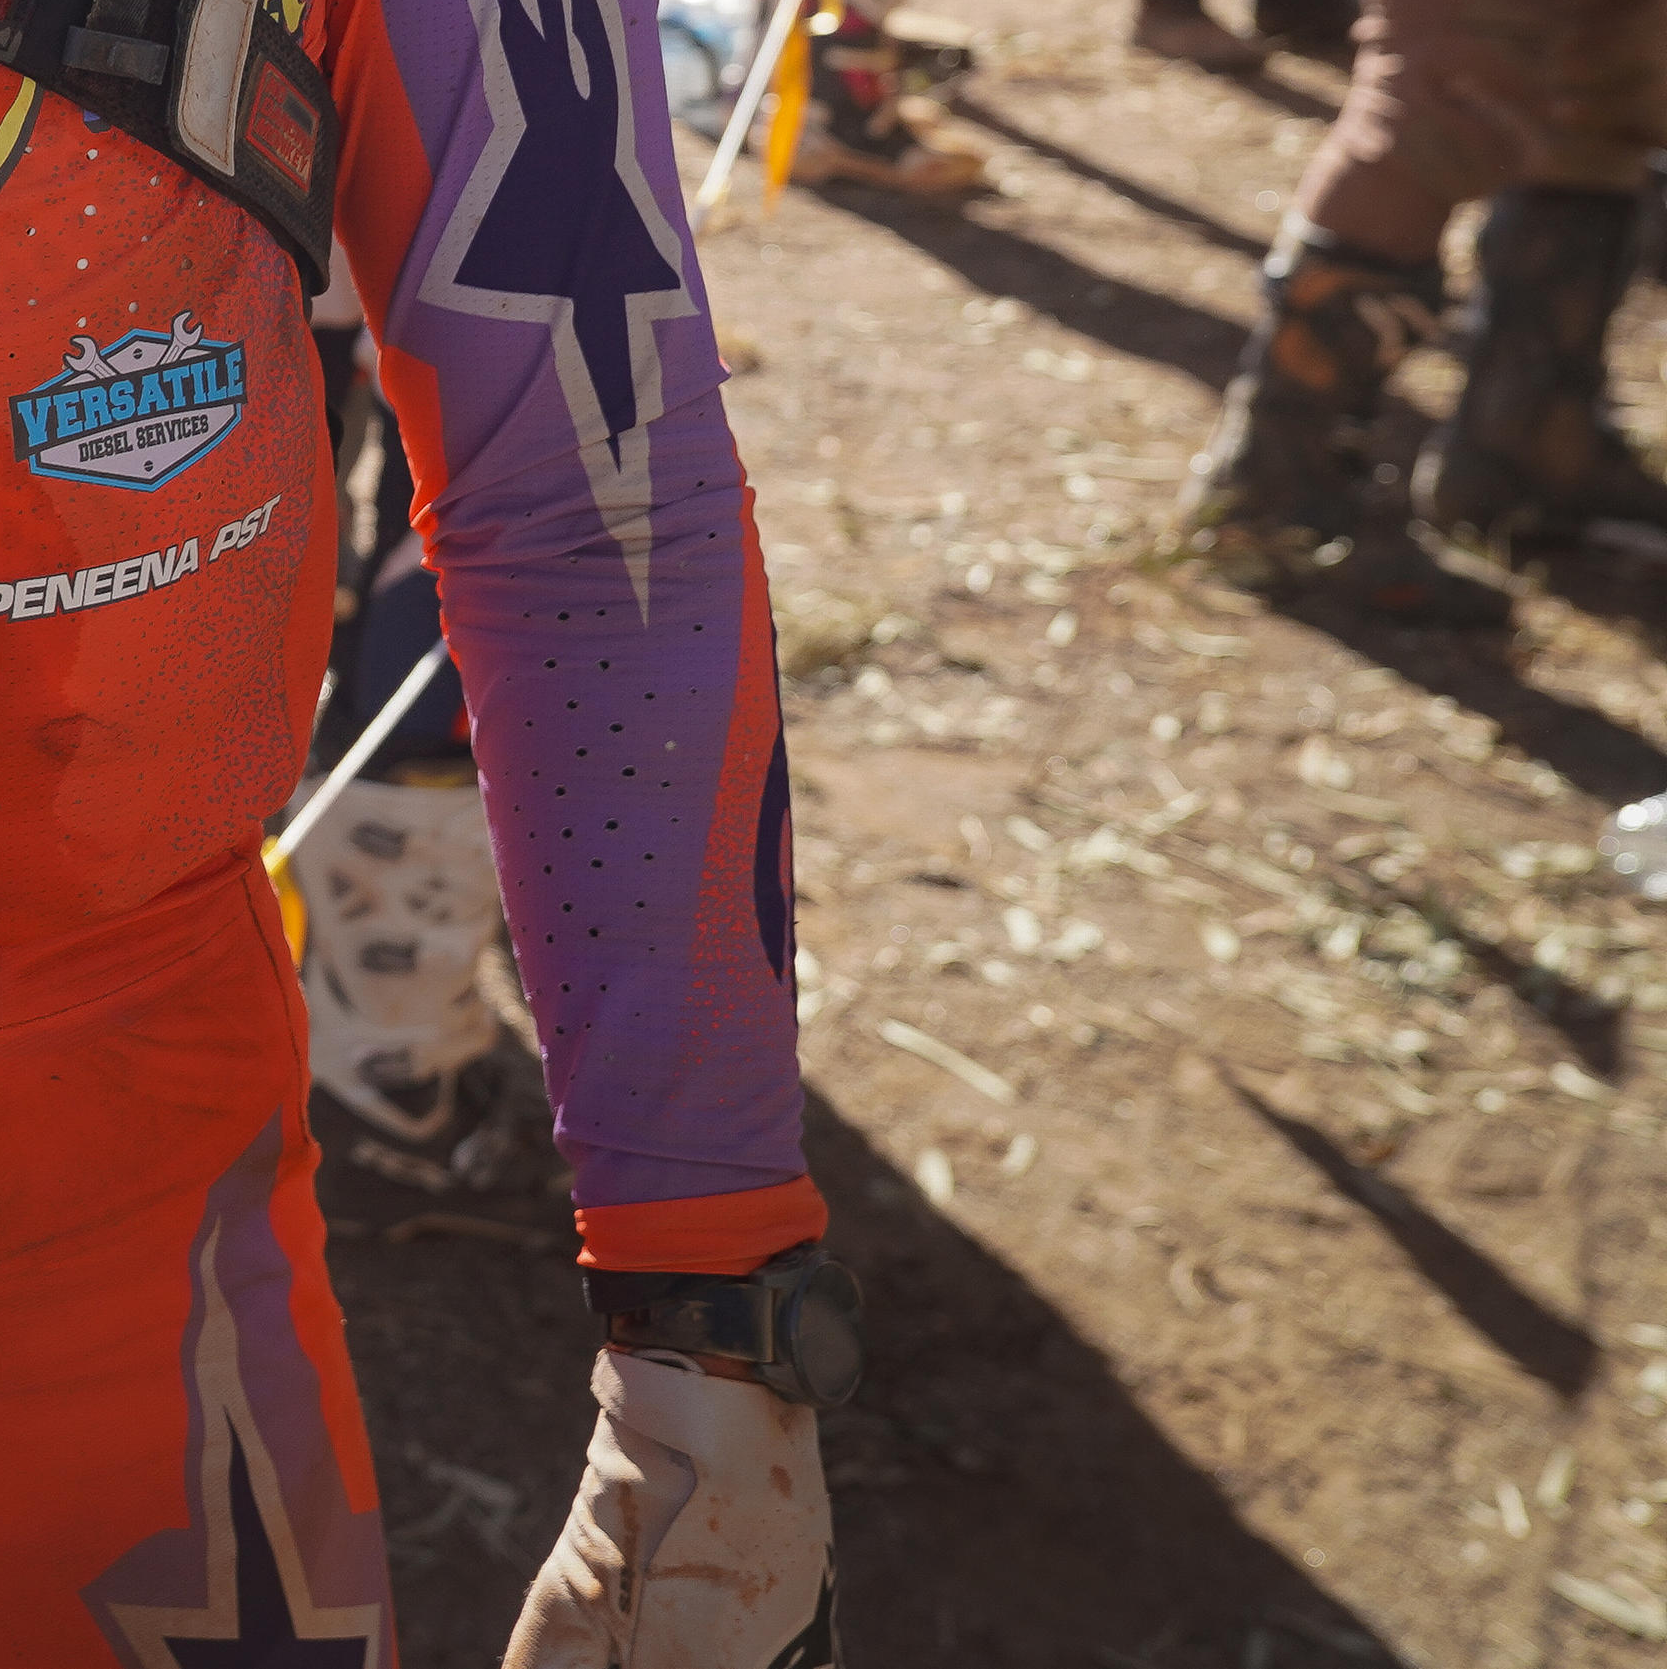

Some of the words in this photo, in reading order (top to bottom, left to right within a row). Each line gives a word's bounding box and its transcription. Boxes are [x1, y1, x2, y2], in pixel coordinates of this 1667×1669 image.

[17, 349, 244, 448] VERSATILE
[79, 432, 133, 462] DIESEL
[137, 415, 209, 450] SERVICES
[209, 494, 282, 562] PST
